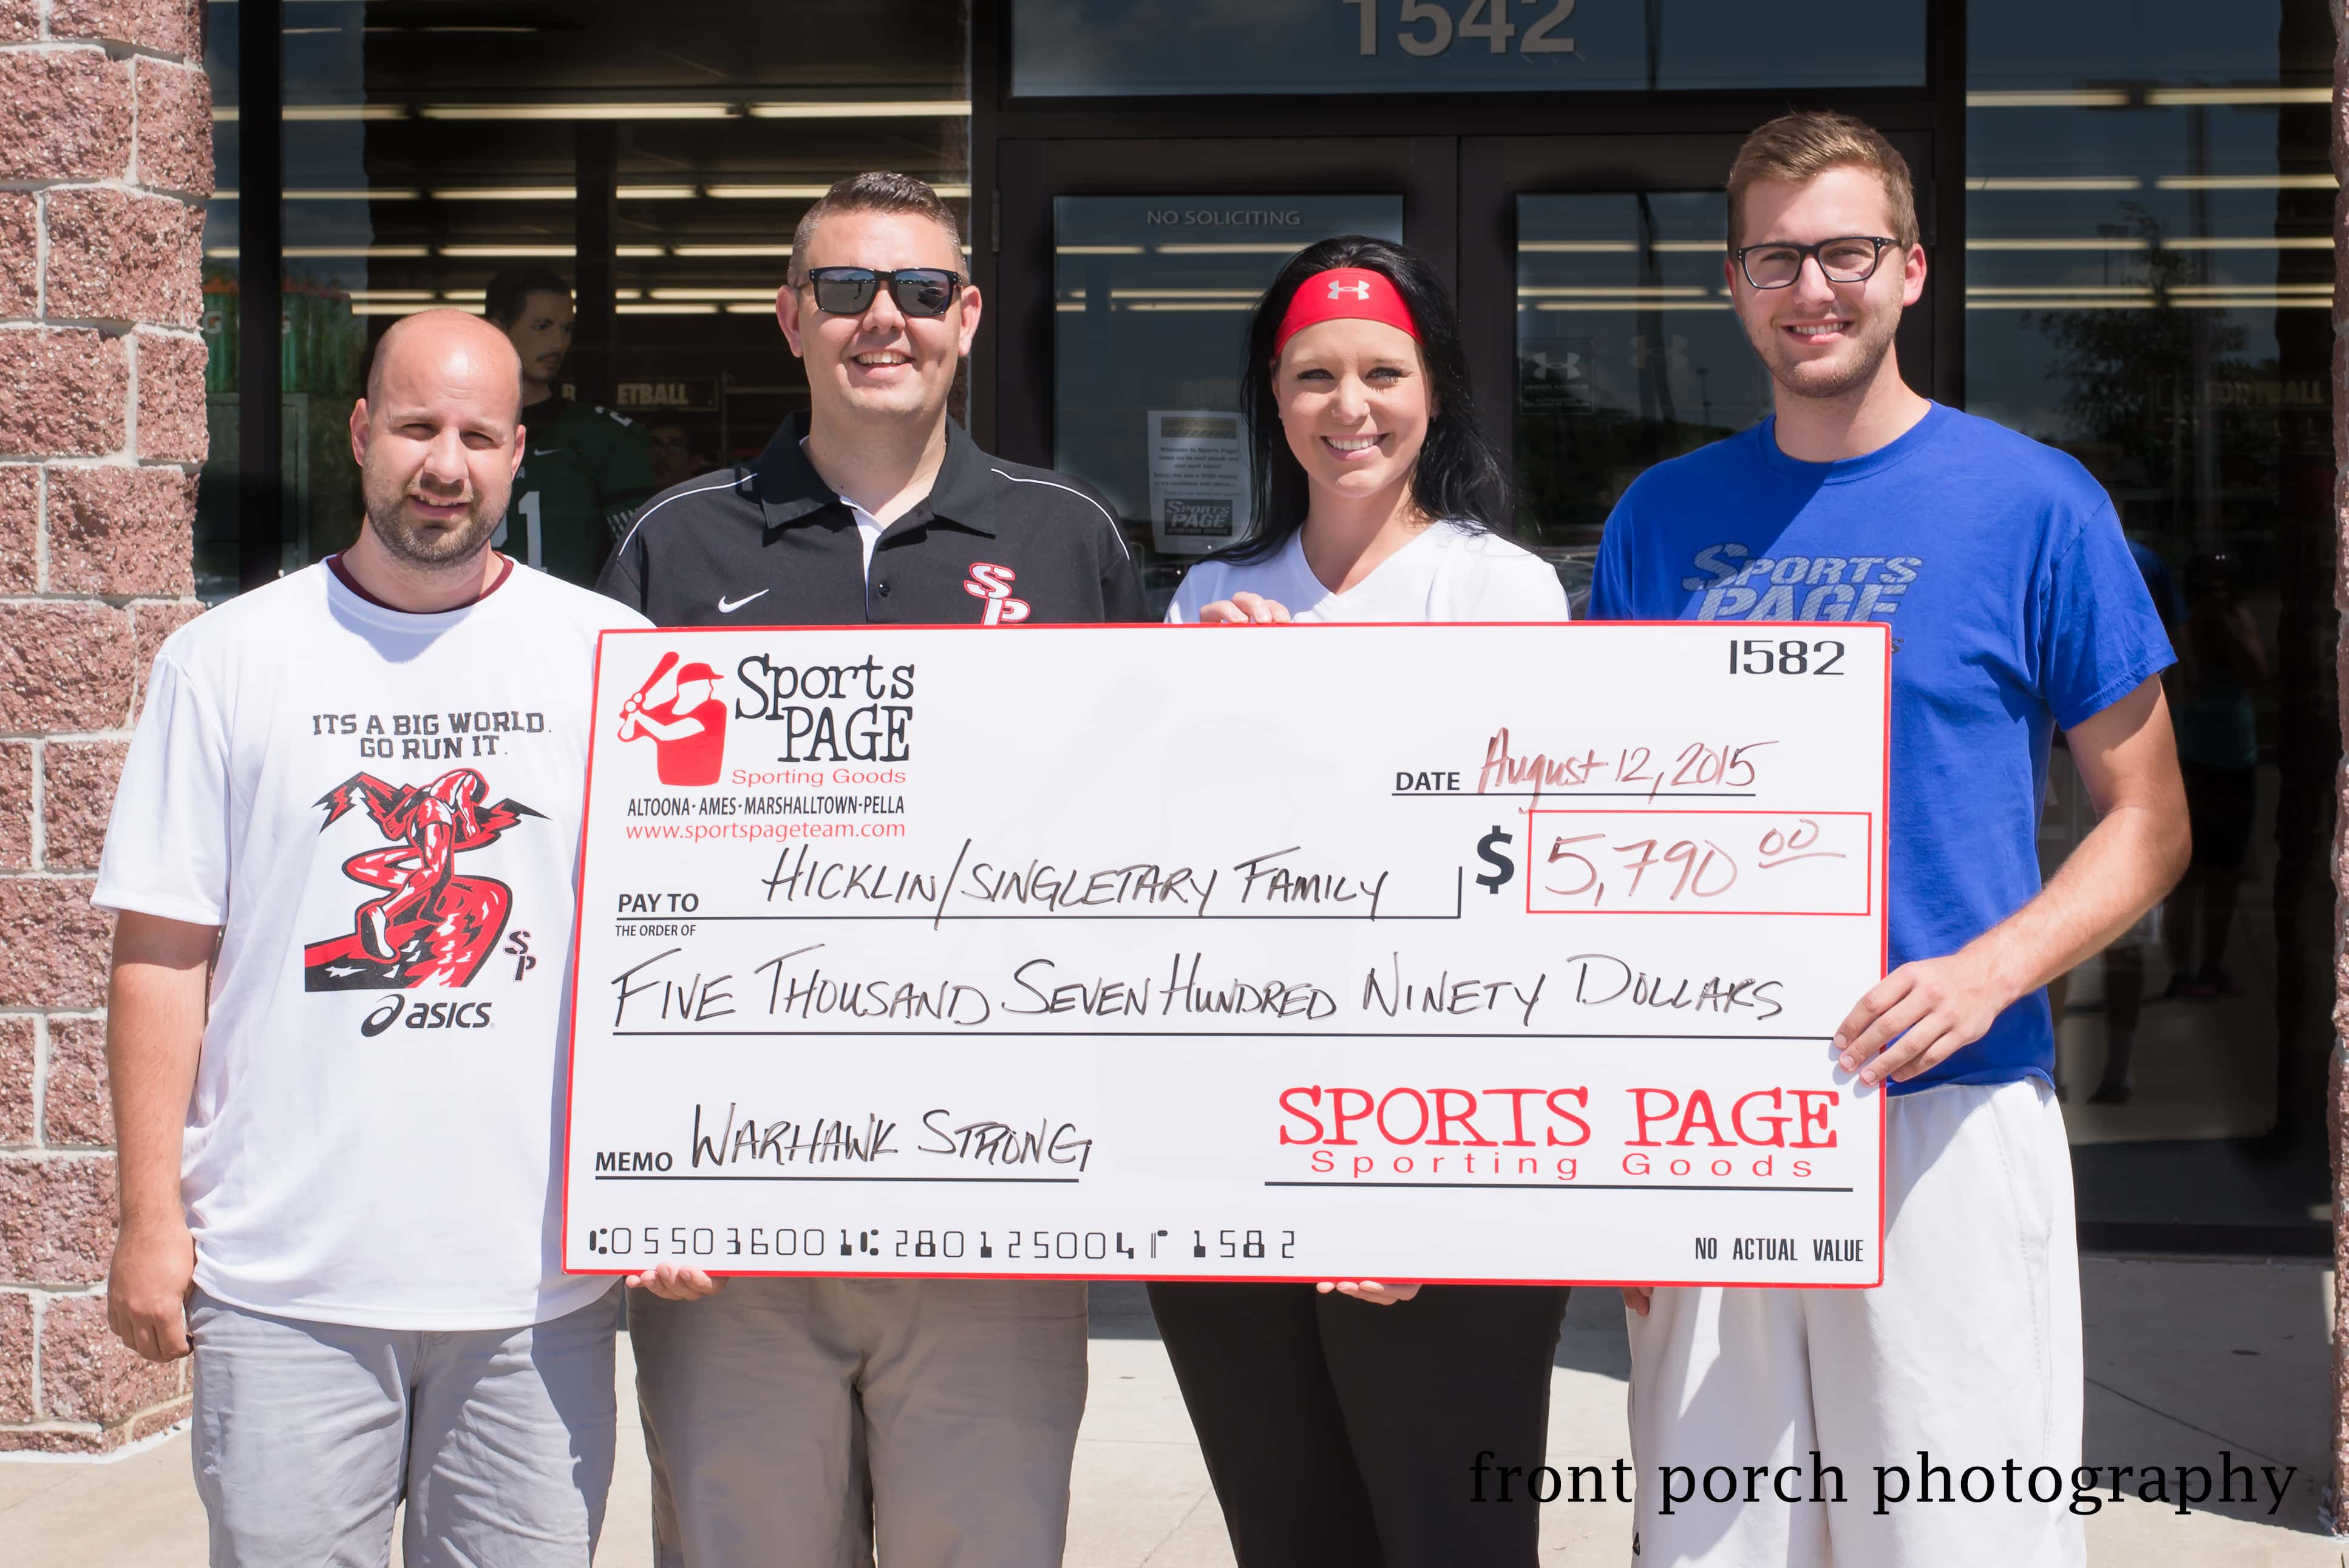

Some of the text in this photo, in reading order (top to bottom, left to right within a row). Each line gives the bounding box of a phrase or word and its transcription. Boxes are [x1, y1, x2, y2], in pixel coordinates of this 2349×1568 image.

[1345, 0, 1576, 56] 1542
[1147, 210, 1300, 226] NO SOLICITING
[1171, 514, 1227, 528] PAGE
[1681, 542, 1923, 592] SPORTS
[1729, 640, 1845, 675] 1582
[735, 653, 914, 720] Sports
[313, 714, 357, 735] ITS
[366, 715, 385, 735] A
[393, 714, 439, 735] BIG
[778, 703, 913, 762] PAGE
[361, 738, 393, 758] GO
[402, 736, 462, 759] RUN
[732, 768, 906, 787] Sporting Goods
[1396, 772, 1460, 791] DATE
[1478, 727, 1608, 814] August
[1670, 740, 1780, 787] 2015
[626, 820, 905, 843] www.sportspageteam.com
[1476, 826, 1514, 894] $
[618, 893, 699, 912] PAY TO
[615, 925, 696, 936] THE ORDER OF
[1279, 1085, 1840, 1149] SPORTS PAGE
[596, 1152, 673, 1172] MEMO
[1310, 1150, 1812, 1181] Sporting Goods
[1695, 1237, 1864, 1262] NO ACTUAL VALUE
